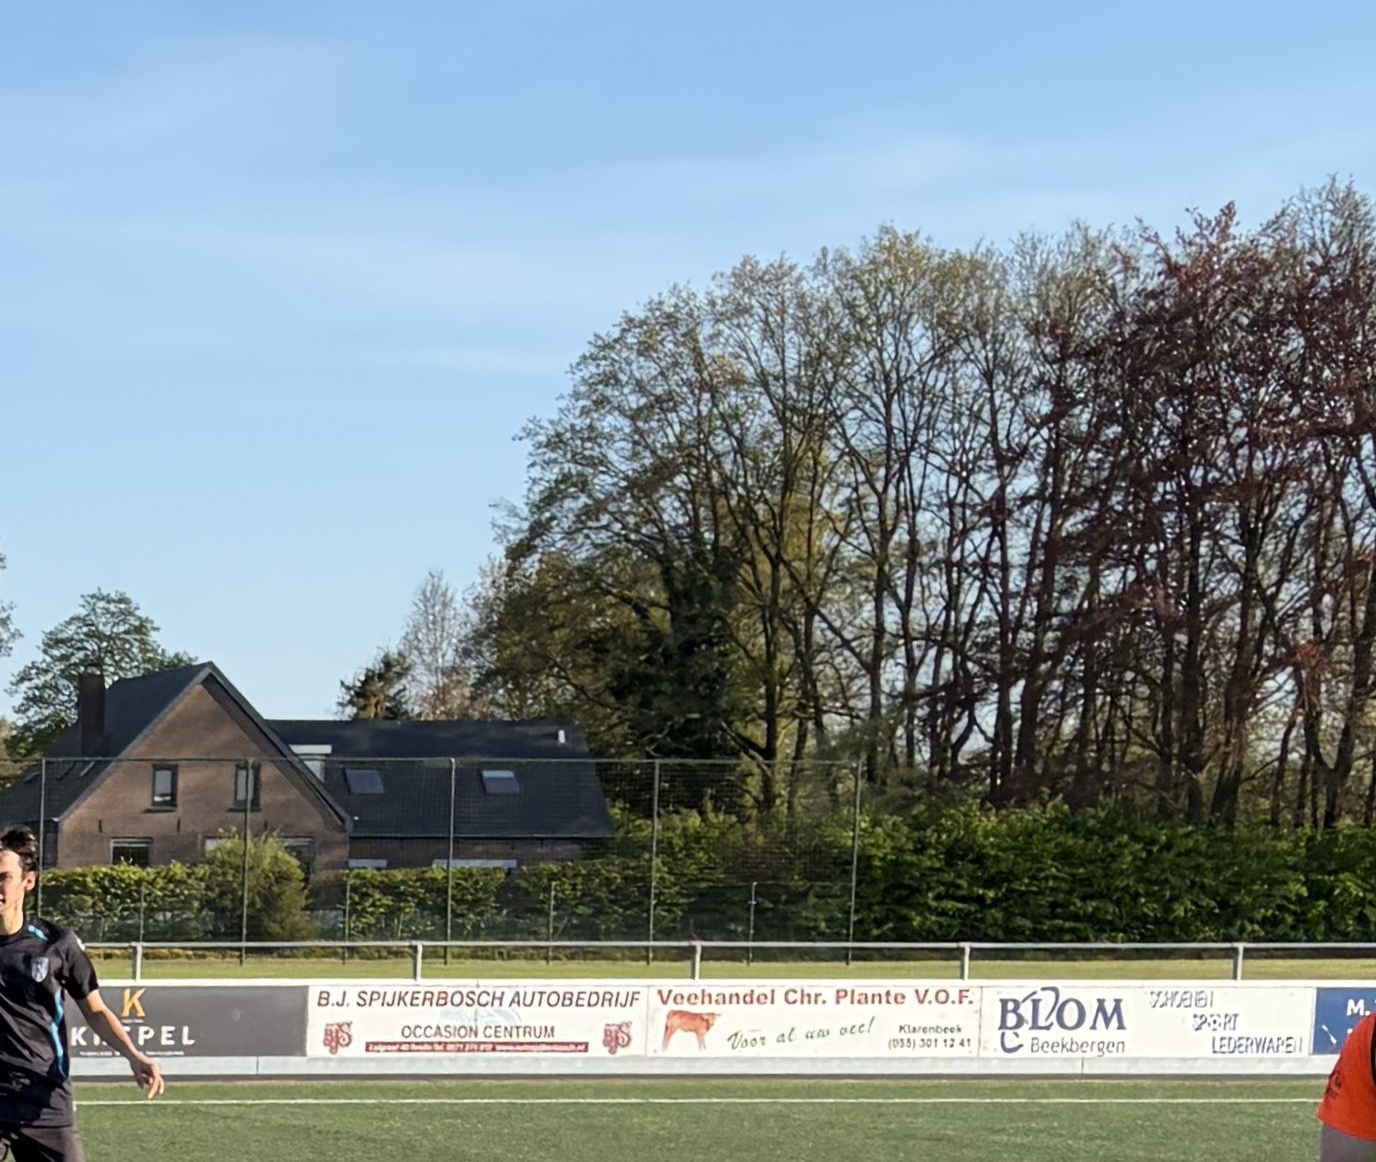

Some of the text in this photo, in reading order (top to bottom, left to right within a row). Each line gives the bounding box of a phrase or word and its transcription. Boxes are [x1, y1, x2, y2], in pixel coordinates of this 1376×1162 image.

[120, 988, 146, 1017] K
[317, 990, 641, 1008] B.J. SPIJKERBOSCH AUTOBEDRIJF
[656, 988, 974, 1006] Veehandel Chr. Plante V.O.F.
[997, 987, 1127, 1031] BLOM
[70, 1025, 196, 1046] KPEL
[400, 1025, 555, 1039] OCCASION CENTRUM
[727, 1029, 766, 1050] Voor
[899, 1024, 962, 1034] Klarenbeek
[1030, 1036, 1126, 1057] Beekbergen
